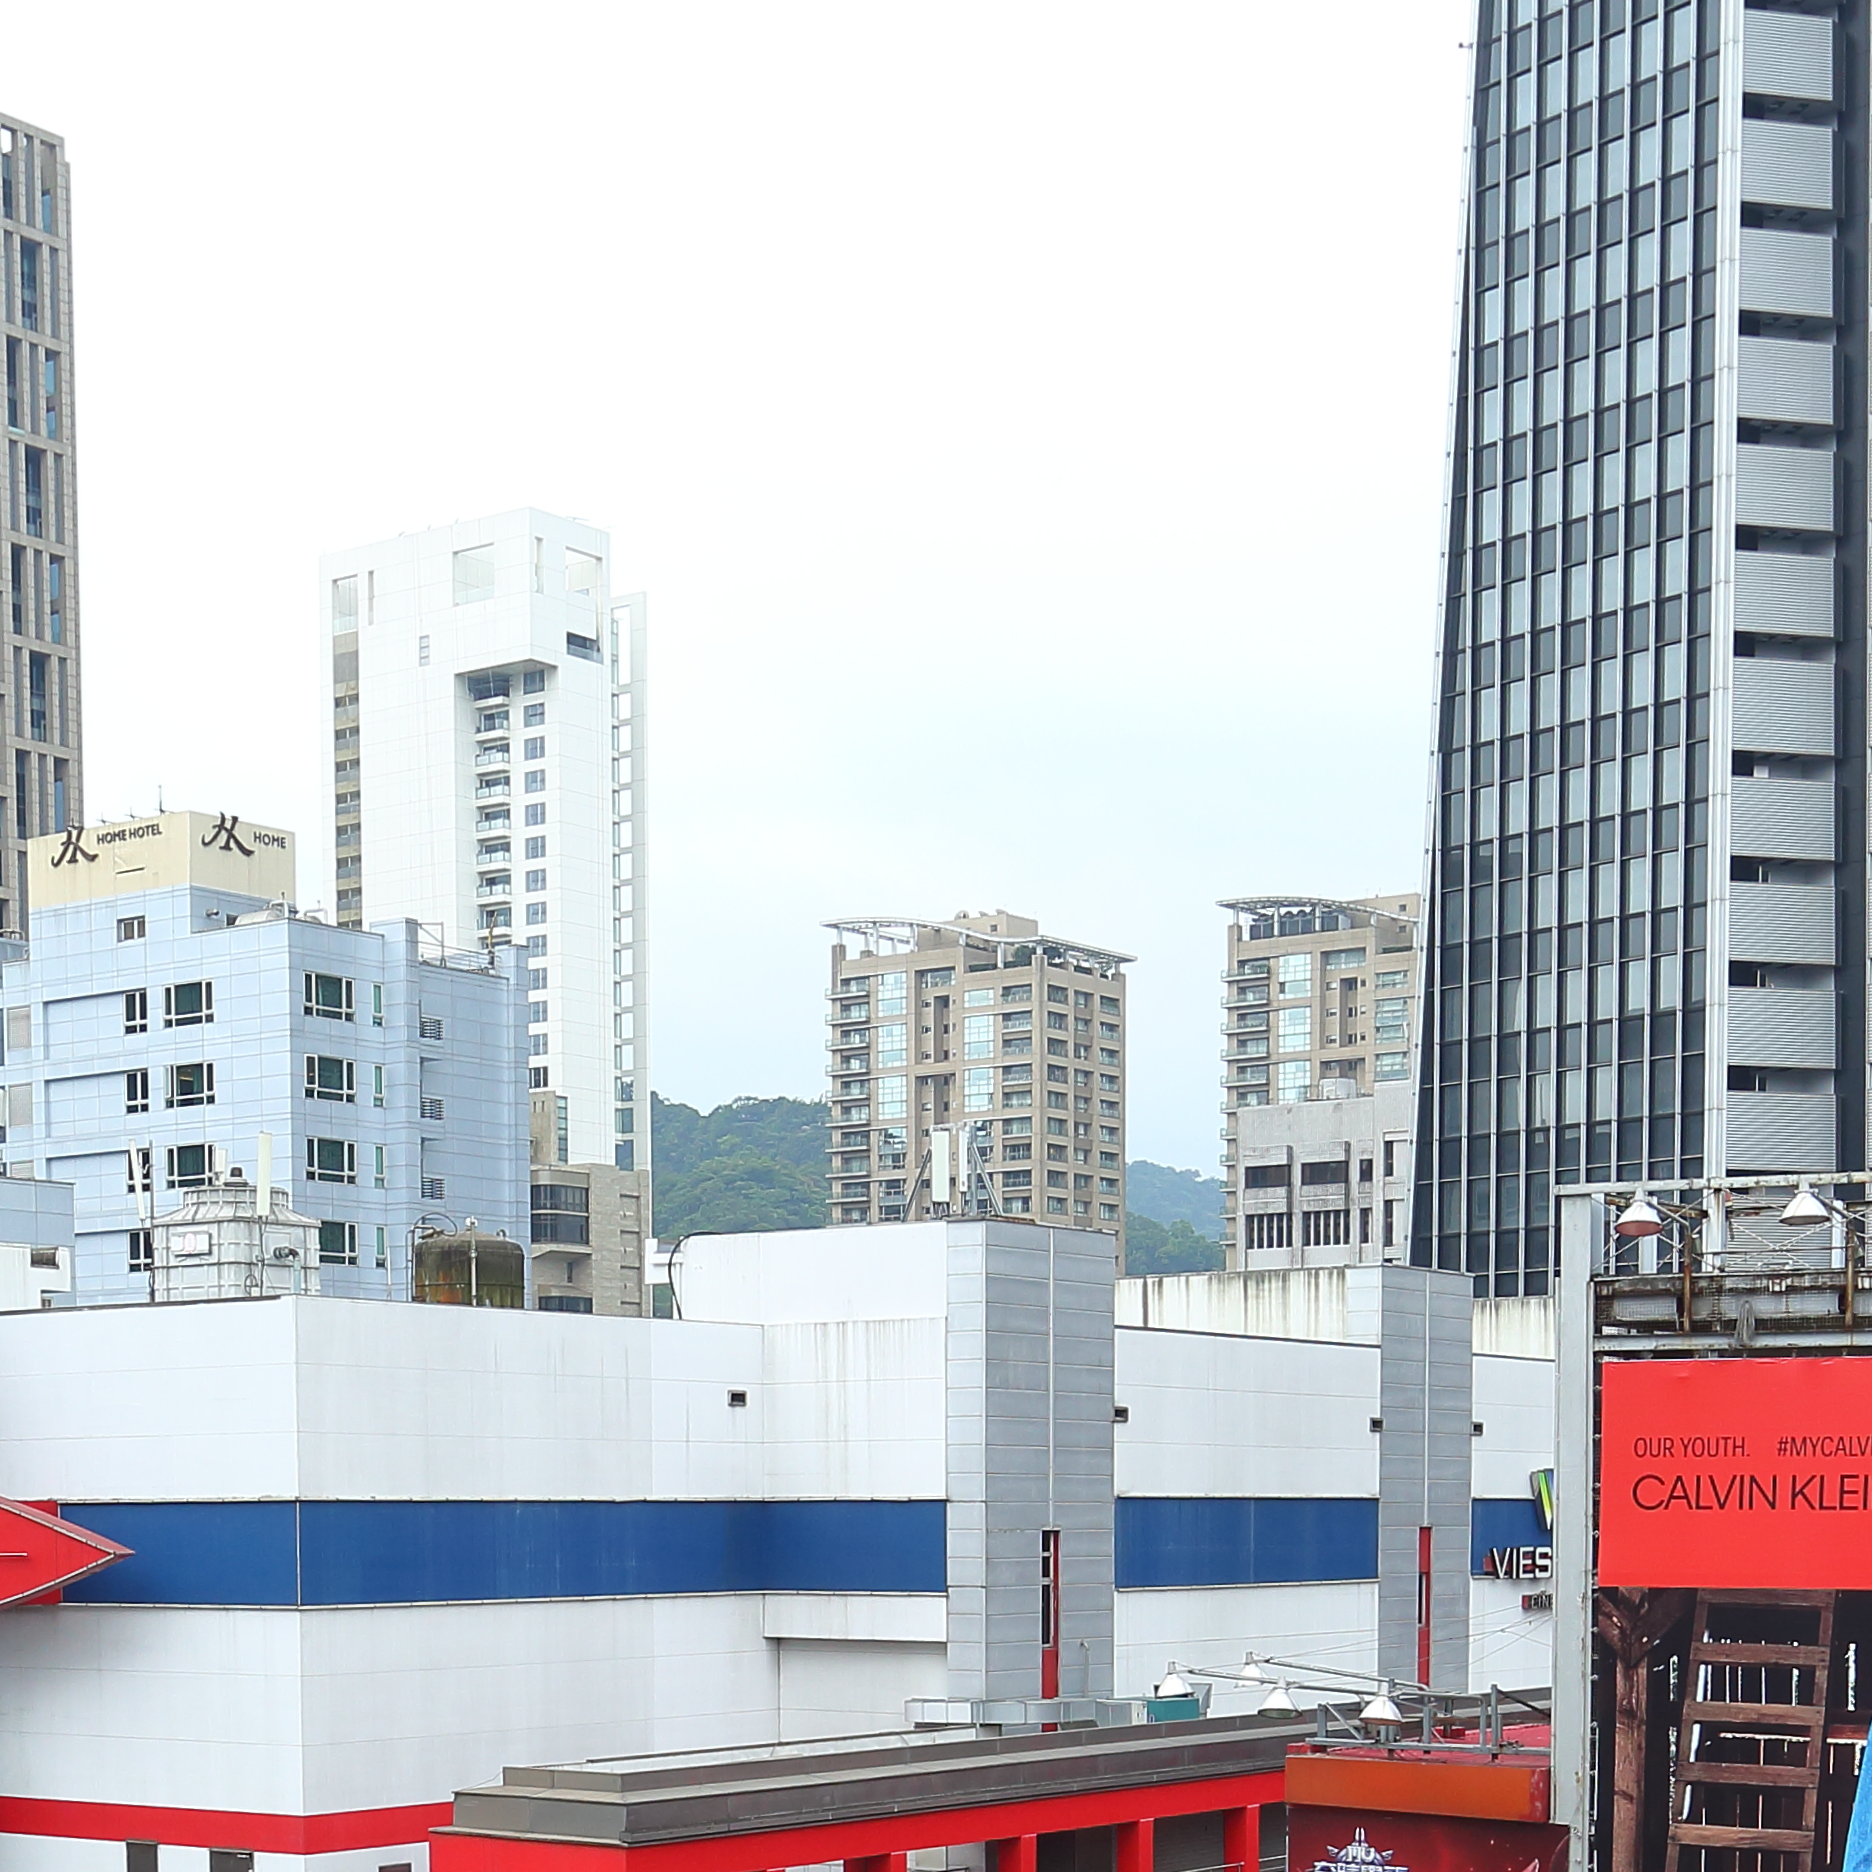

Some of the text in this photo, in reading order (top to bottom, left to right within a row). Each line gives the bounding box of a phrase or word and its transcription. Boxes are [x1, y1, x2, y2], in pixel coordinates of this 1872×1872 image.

[96, 823, 162, 845] HOME HOTEL
[254, 831, 286, 849] HOME
[1633, 1437, 1675, 1458] OUR
[1679, 1436, 1751, 1458] YOUTH.
[1632, 1473, 1778, 1512] CALVIN
